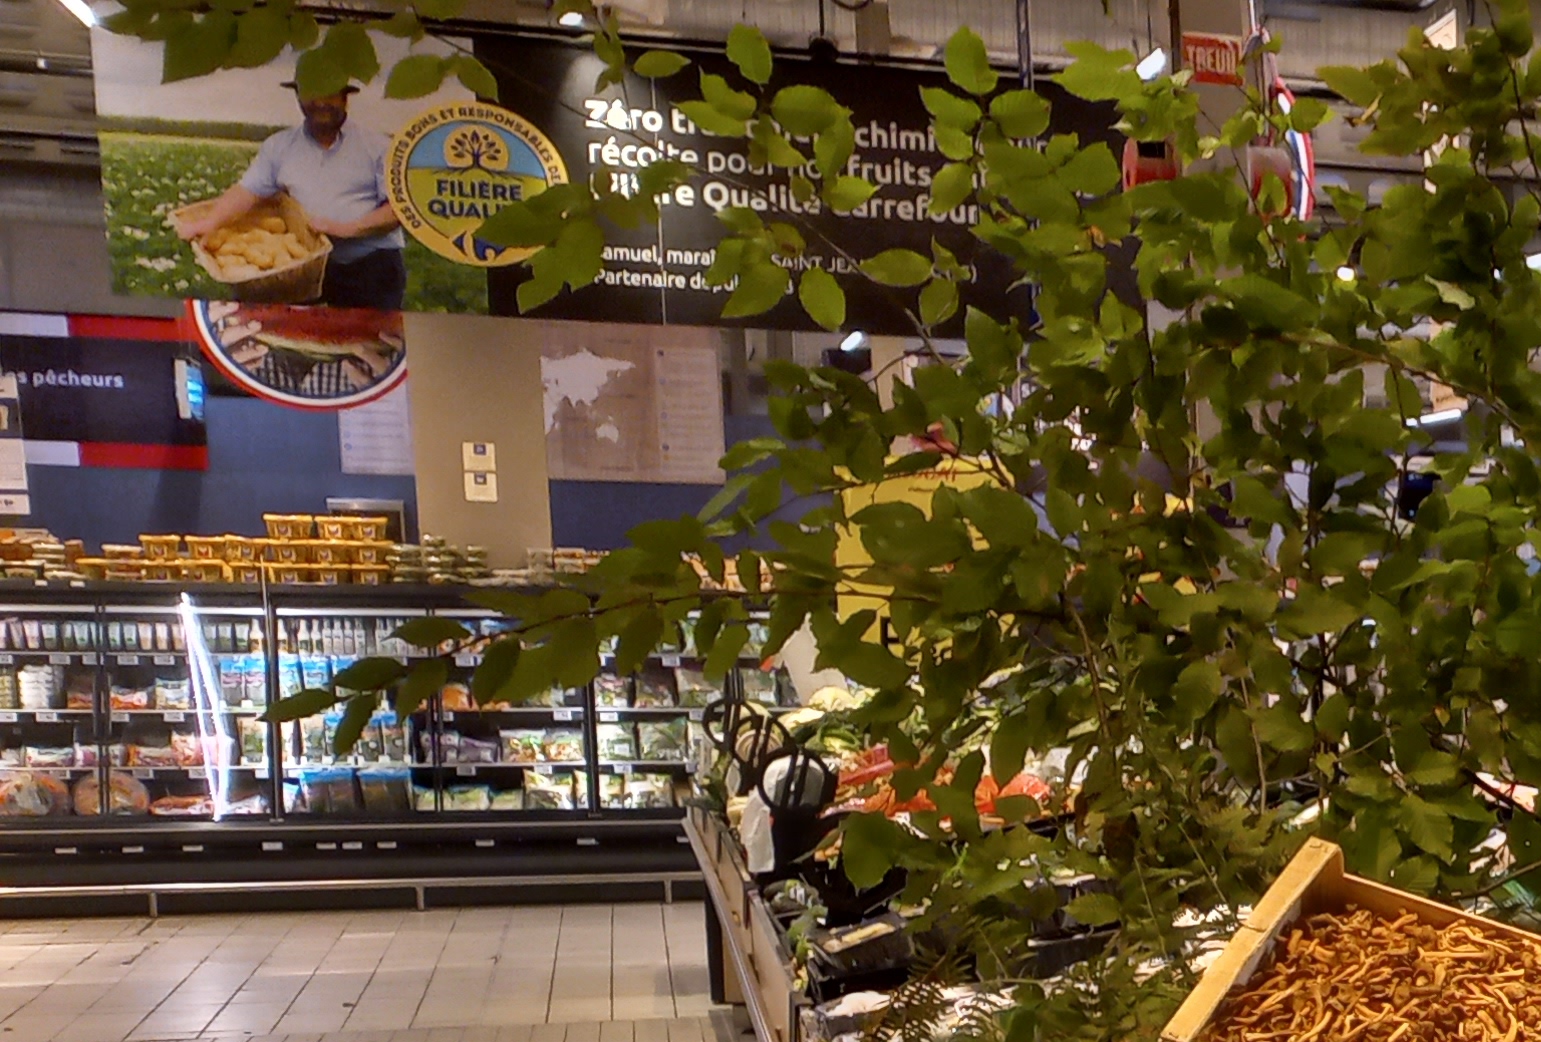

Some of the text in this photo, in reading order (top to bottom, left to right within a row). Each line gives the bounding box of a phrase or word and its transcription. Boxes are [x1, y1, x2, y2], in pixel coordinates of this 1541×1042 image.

[435, 177, 522, 202] FILIÈRE
[427, 198, 505, 221] QUAL
[601, 244, 663, 266] amuel,
[666, 249, 716, 266] mara
[594, 268, 686, 289] Partenaire
[32, 369, 125, 389] pêcheurs
